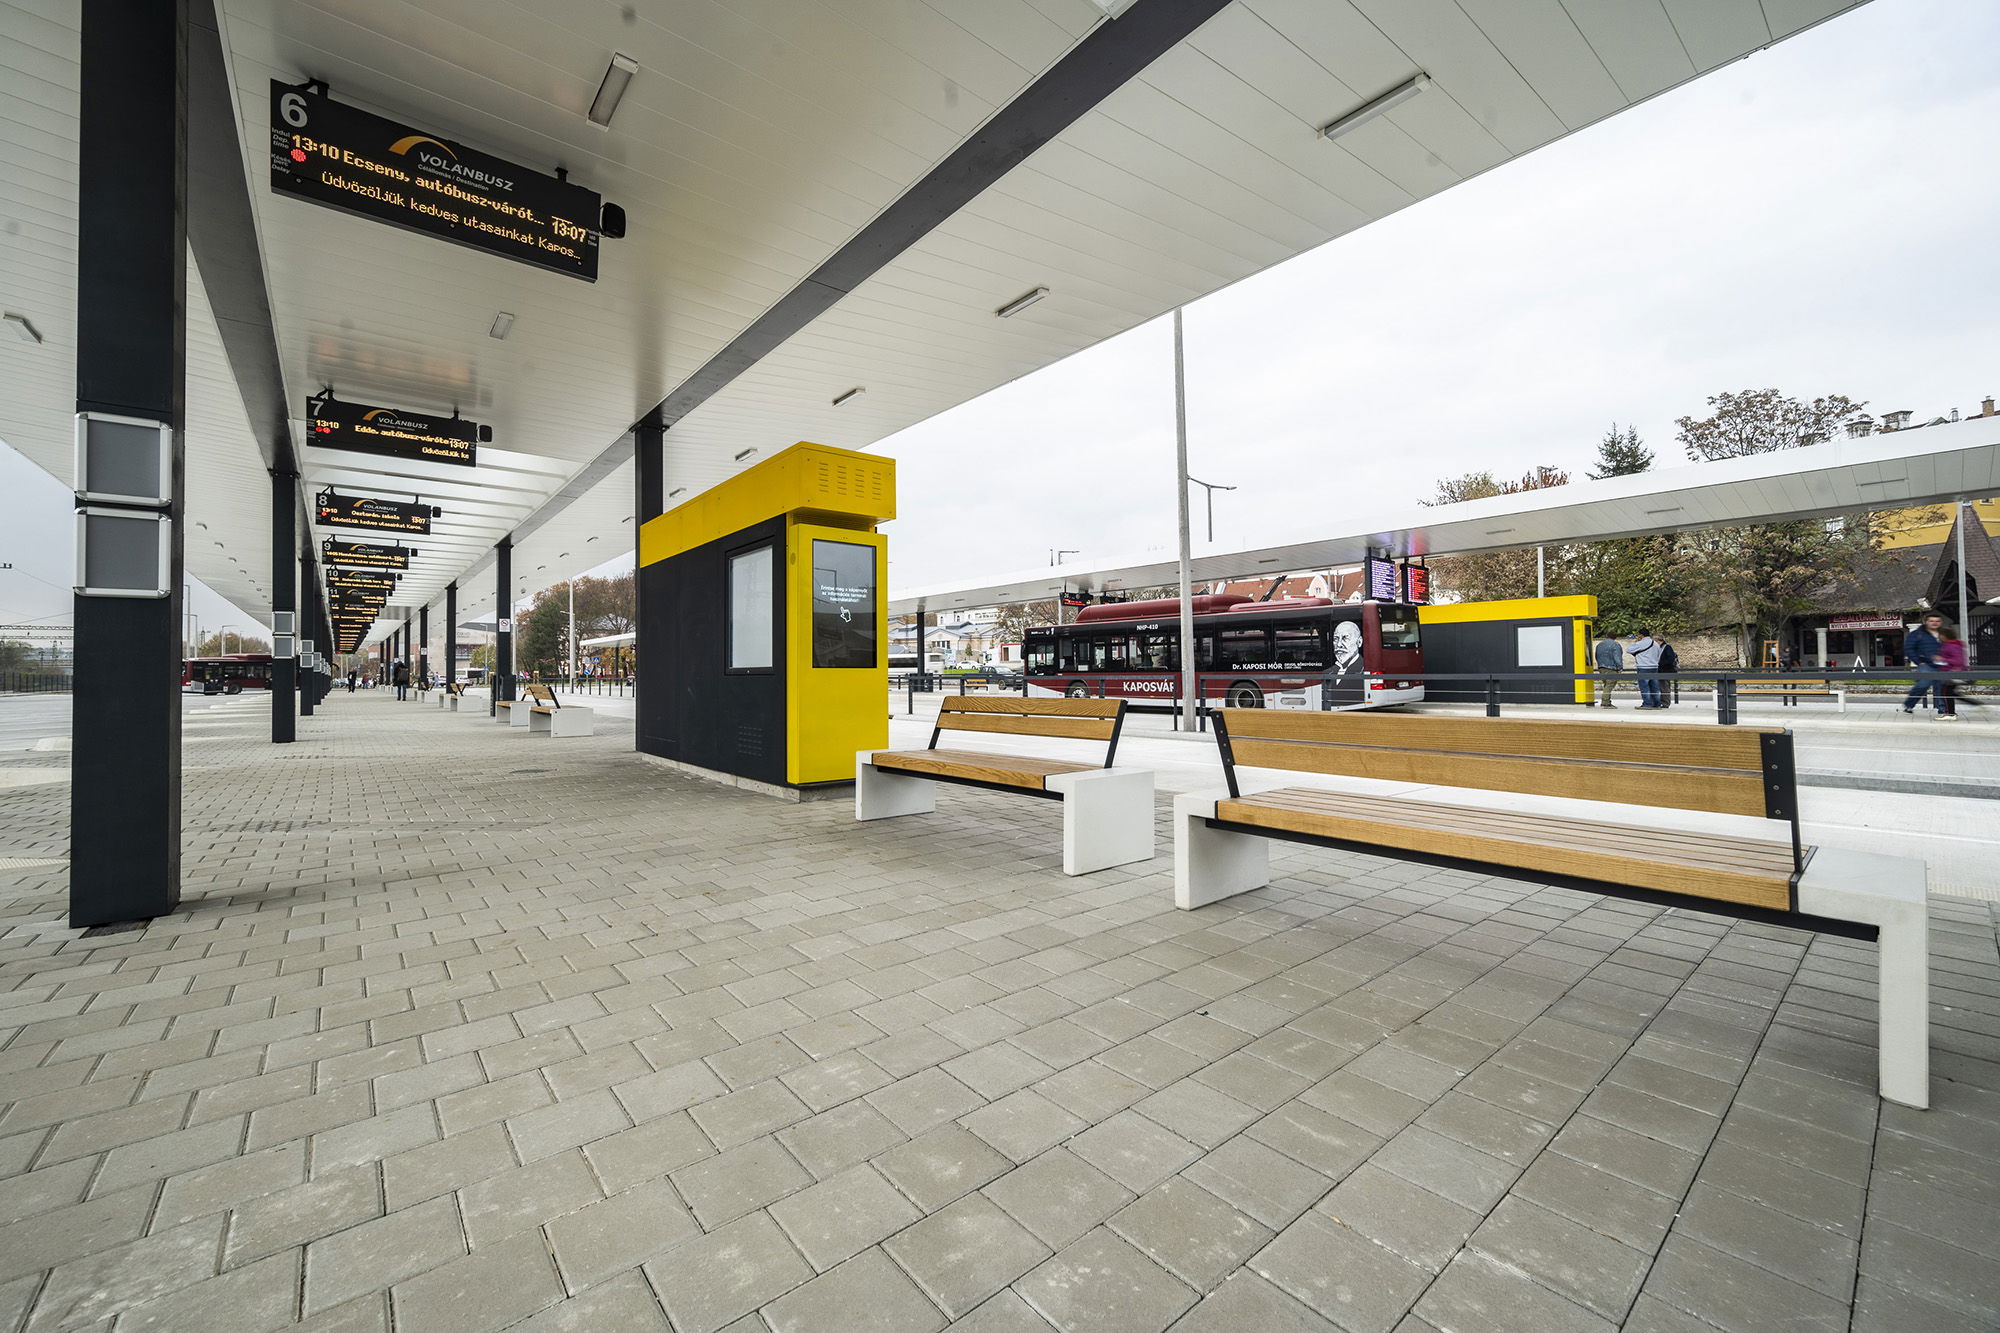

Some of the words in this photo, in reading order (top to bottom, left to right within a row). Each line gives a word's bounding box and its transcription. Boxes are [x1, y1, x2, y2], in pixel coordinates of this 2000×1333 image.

[280, 93, 308, 128] 6
[272, 127, 290, 138] Indul
[272, 134, 289, 144] Dep.
[272, 140, 289, 149] time
[292, 134, 340, 160] 13:10
[342, 149, 410, 182] Ecseny,
[272, 164, 290, 174] Delay
[419, 151, 514, 192] VOLÁNBUSZ
[456, 175, 490, 192] Destination
[321, 171, 406, 208] Üdvözöljük
[410, 197, 459, 222] kedves
[463, 216, 534, 246] utasainkat
[552, 219, 587, 244] 13:07
[310, 400, 324, 416] 7
[315, 418, 340, 430] 13:10
[378, 416, 428, 430] VOLÁNBUSZ
[449, 440, 470, 450] 13:07
[318, 495, 328, 506] 8
[324, 542, 331, 551] 9
[1268, 662, 1283, 670] MÓR
